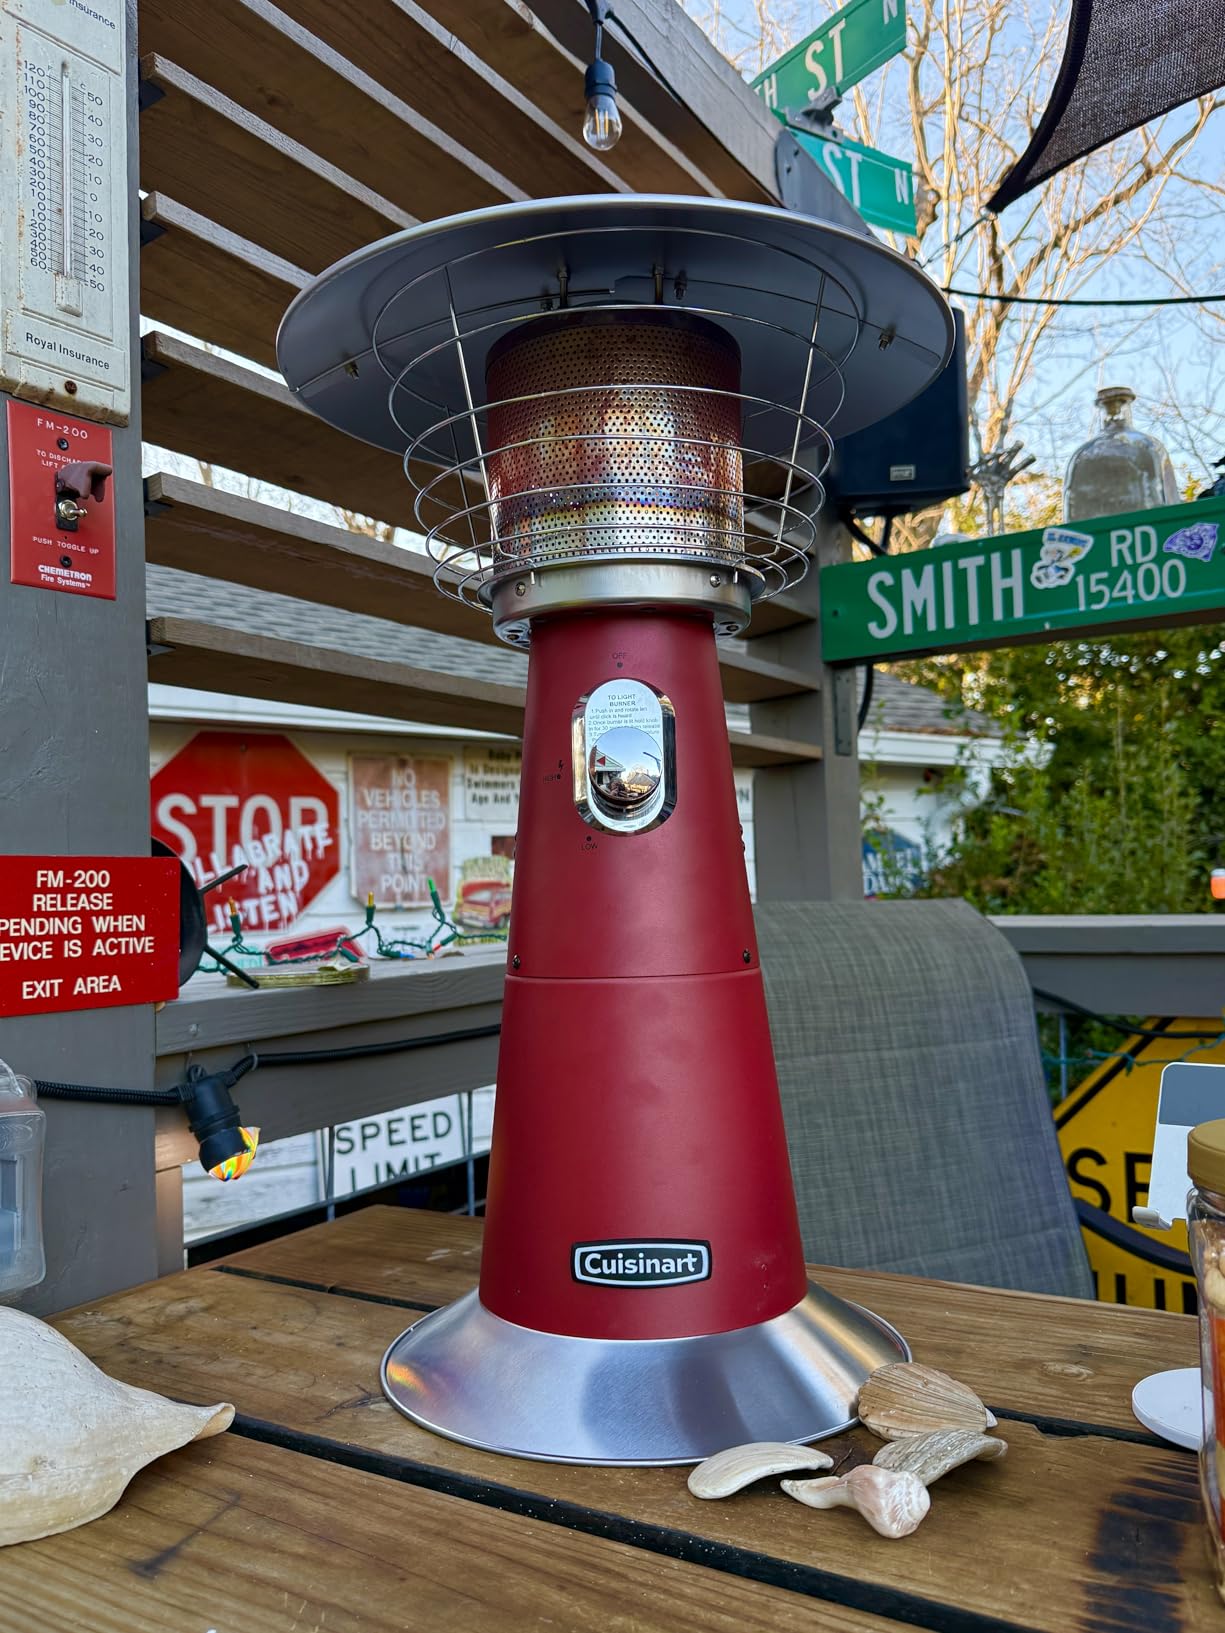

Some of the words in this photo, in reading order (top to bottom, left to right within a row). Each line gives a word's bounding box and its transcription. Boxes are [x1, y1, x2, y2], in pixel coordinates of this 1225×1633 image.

[804, 18, 846, 100] ST
[24, 60, 46, 78] 120
[24, 72, 46, 90] 110
[24, 85, 46, 102] 100
[754, 72, 778, 109] H
[28, 99, 46, 114] 90
[87, 92, 104, 106] 50
[28, 110, 46, 124] 80
[88, 114, 104, 128] 40
[29, 123, 46, 136] 70
[28, 134, 46, 148] 60
[88, 133, 104, 148] 30
[29, 144, 46, 158] 50
[28, 157, 46, 170] 40
[88, 154, 104, 168] 20
[28, 167, 46, 180] 30
[88, 172, 103, 186] 10
[822, 142, 862, 208] ST
[29, 178, 46, 191] 20
[894, 168, 908, 205] N
[32, 188, 46, 201] 10
[90, 192, 98, 202] 0
[38, 202, 46, 212] 0
[32, 208, 46, 222] 10
[88, 210, 104, 223] 10
[30, 220, 46, 232] 20
[30, 229, 47, 242] 30
[88, 228, 105, 241] 20
[30, 239, 47, 252] 40
[89, 246, 105, 259] 30
[30, 248, 47, 262] 50
[30, 258, 47, 270] 60
[88, 262, 105, 276] 40
[90, 280, 105, 292] 50
[26, 332, 57, 352] Royal
[59, 344, 110, 370] Insurance
[36, 418, 88, 440] FM-200
[36, 448, 46, 458] TO
[49, 453, 82, 464] DISCHA
[41, 460, 58, 469] LIFT
[32, 536, 52, 546] PUSH
[56, 540, 86, 553] TOGGLE
[89, 546, 100, 555] UP
[1110, 526, 1158, 568] RD
[40, 574, 55, 583] Fire
[1075, 559, 1187, 612] 15400
[867, 548, 1024, 640] SMITH
[392, 768, 416, 787] NO
[363, 788, 440, 808] VEHICLES
[156, 792, 330, 867] STOP
[370, 832, 436, 850] BEYOND
[386, 853, 424, 872] THIS
[36, 870, 111, 889] FM-200
[381, 874, 428, 894] POINT
[32, 892, 113, 912] RELEASE
[92, 914, 146, 934] WHEN
[64, 940, 82, 958] IS
[92, 936, 155, 956] ACTIVE
[22, 978, 64, 1000] EXIT
[73, 975, 122, 996] AREA
[335, 1112, 452, 1155] SPEED
[585, 1252, 698, 1274] Cuisinart
